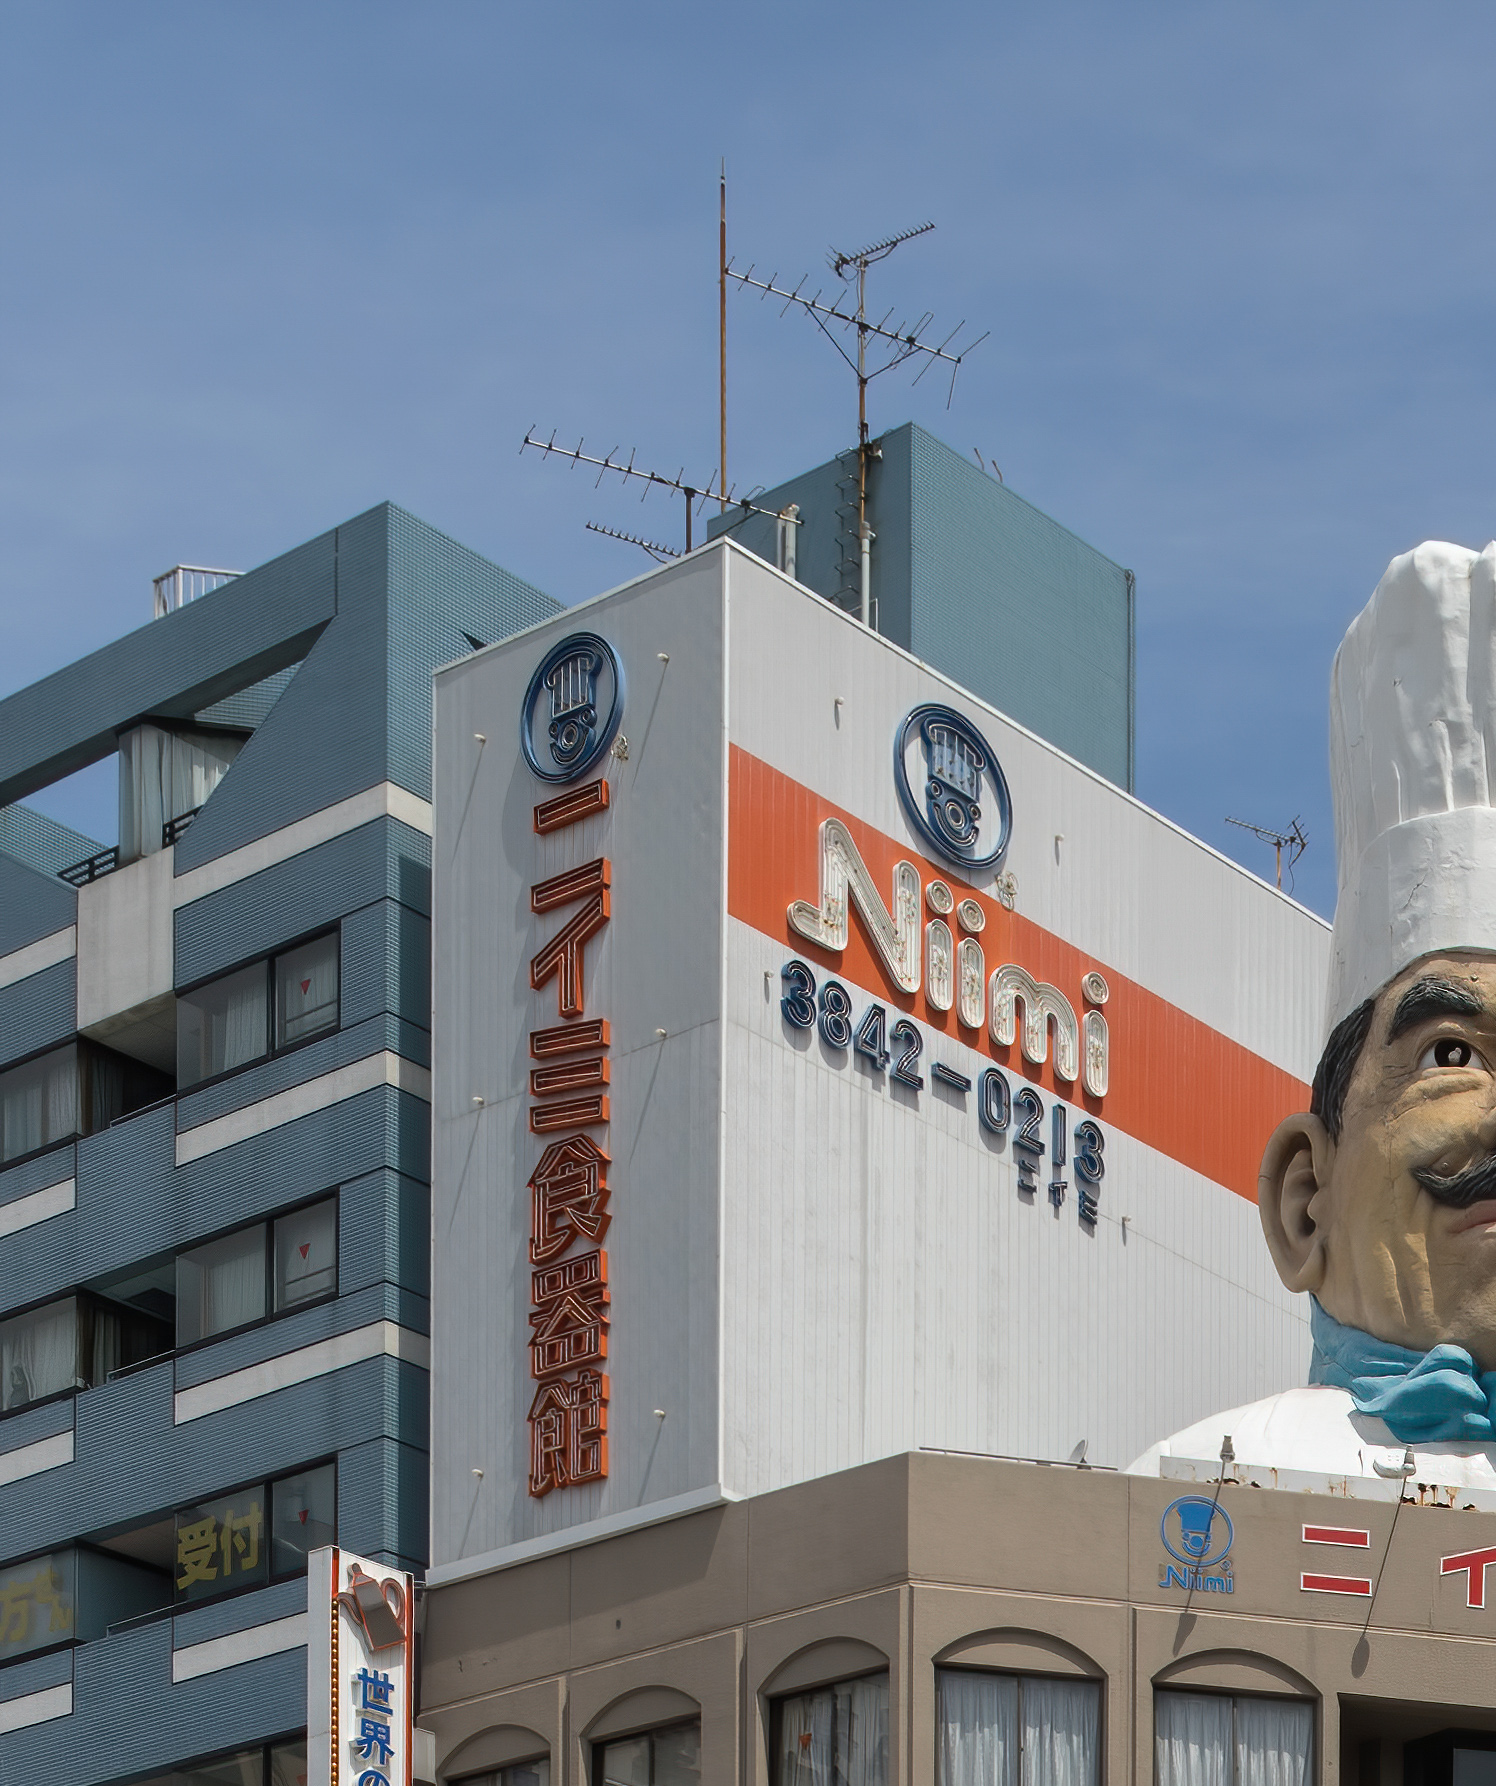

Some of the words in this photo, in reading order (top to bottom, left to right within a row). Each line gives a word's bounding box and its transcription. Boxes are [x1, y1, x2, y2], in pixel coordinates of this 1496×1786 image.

[780, 958, 1105, 1185] 3842-0213
[786, 817, 1111, 1099] Niimi
[529, 777, 611, 1498] ニイミ食器館
[176, 1501, 263, 1590] 受付
[1159, 1565, 1235, 1594] Niimi
